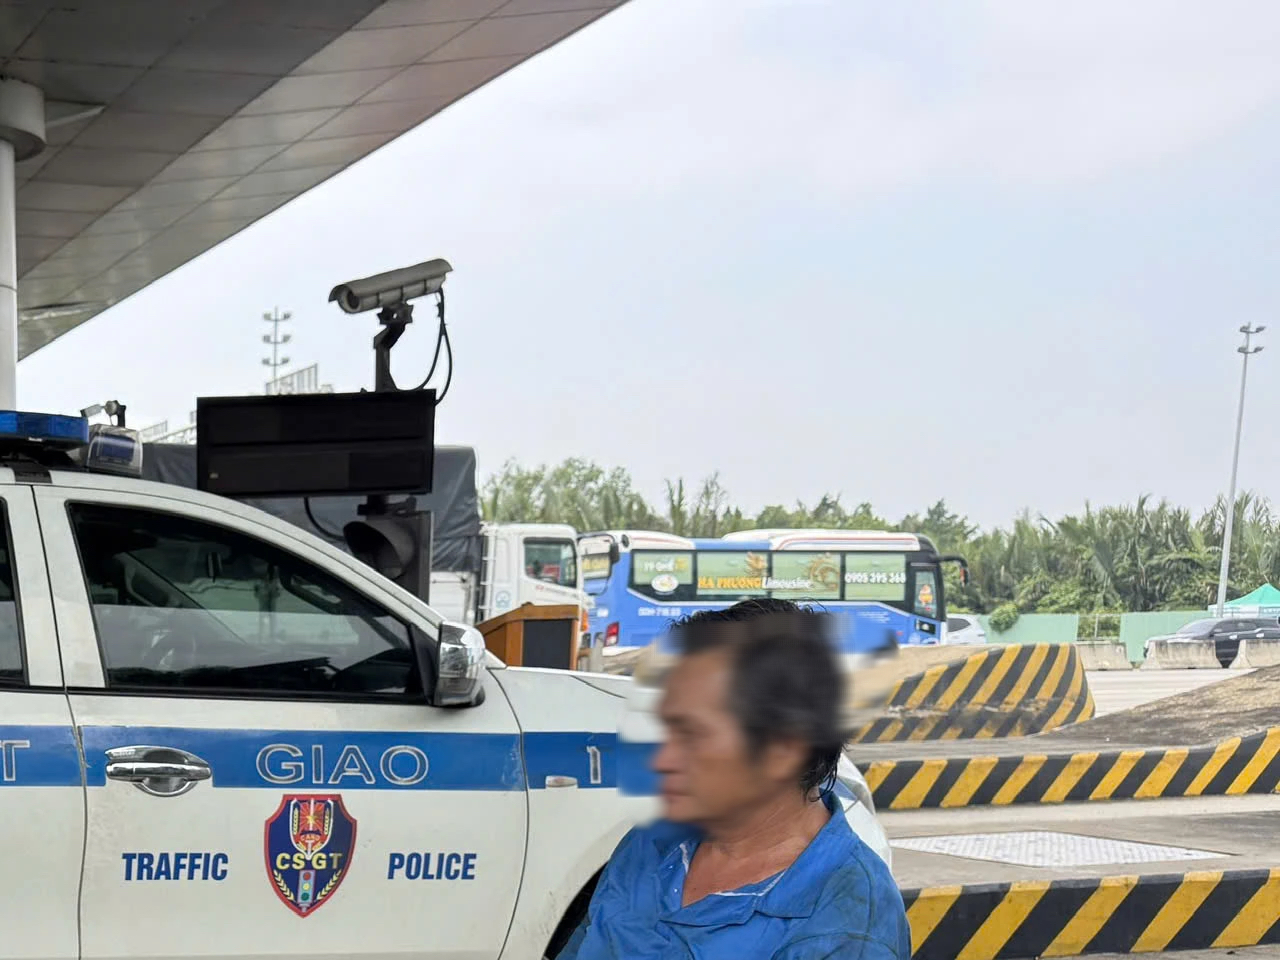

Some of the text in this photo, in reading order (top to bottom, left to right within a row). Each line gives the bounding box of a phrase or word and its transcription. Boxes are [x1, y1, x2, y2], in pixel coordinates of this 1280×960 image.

[256, 744, 429, 786] GIAO
[122, 852, 477, 881] TRAFFIC POLICE
[276, 852, 342, 870] CSGT
